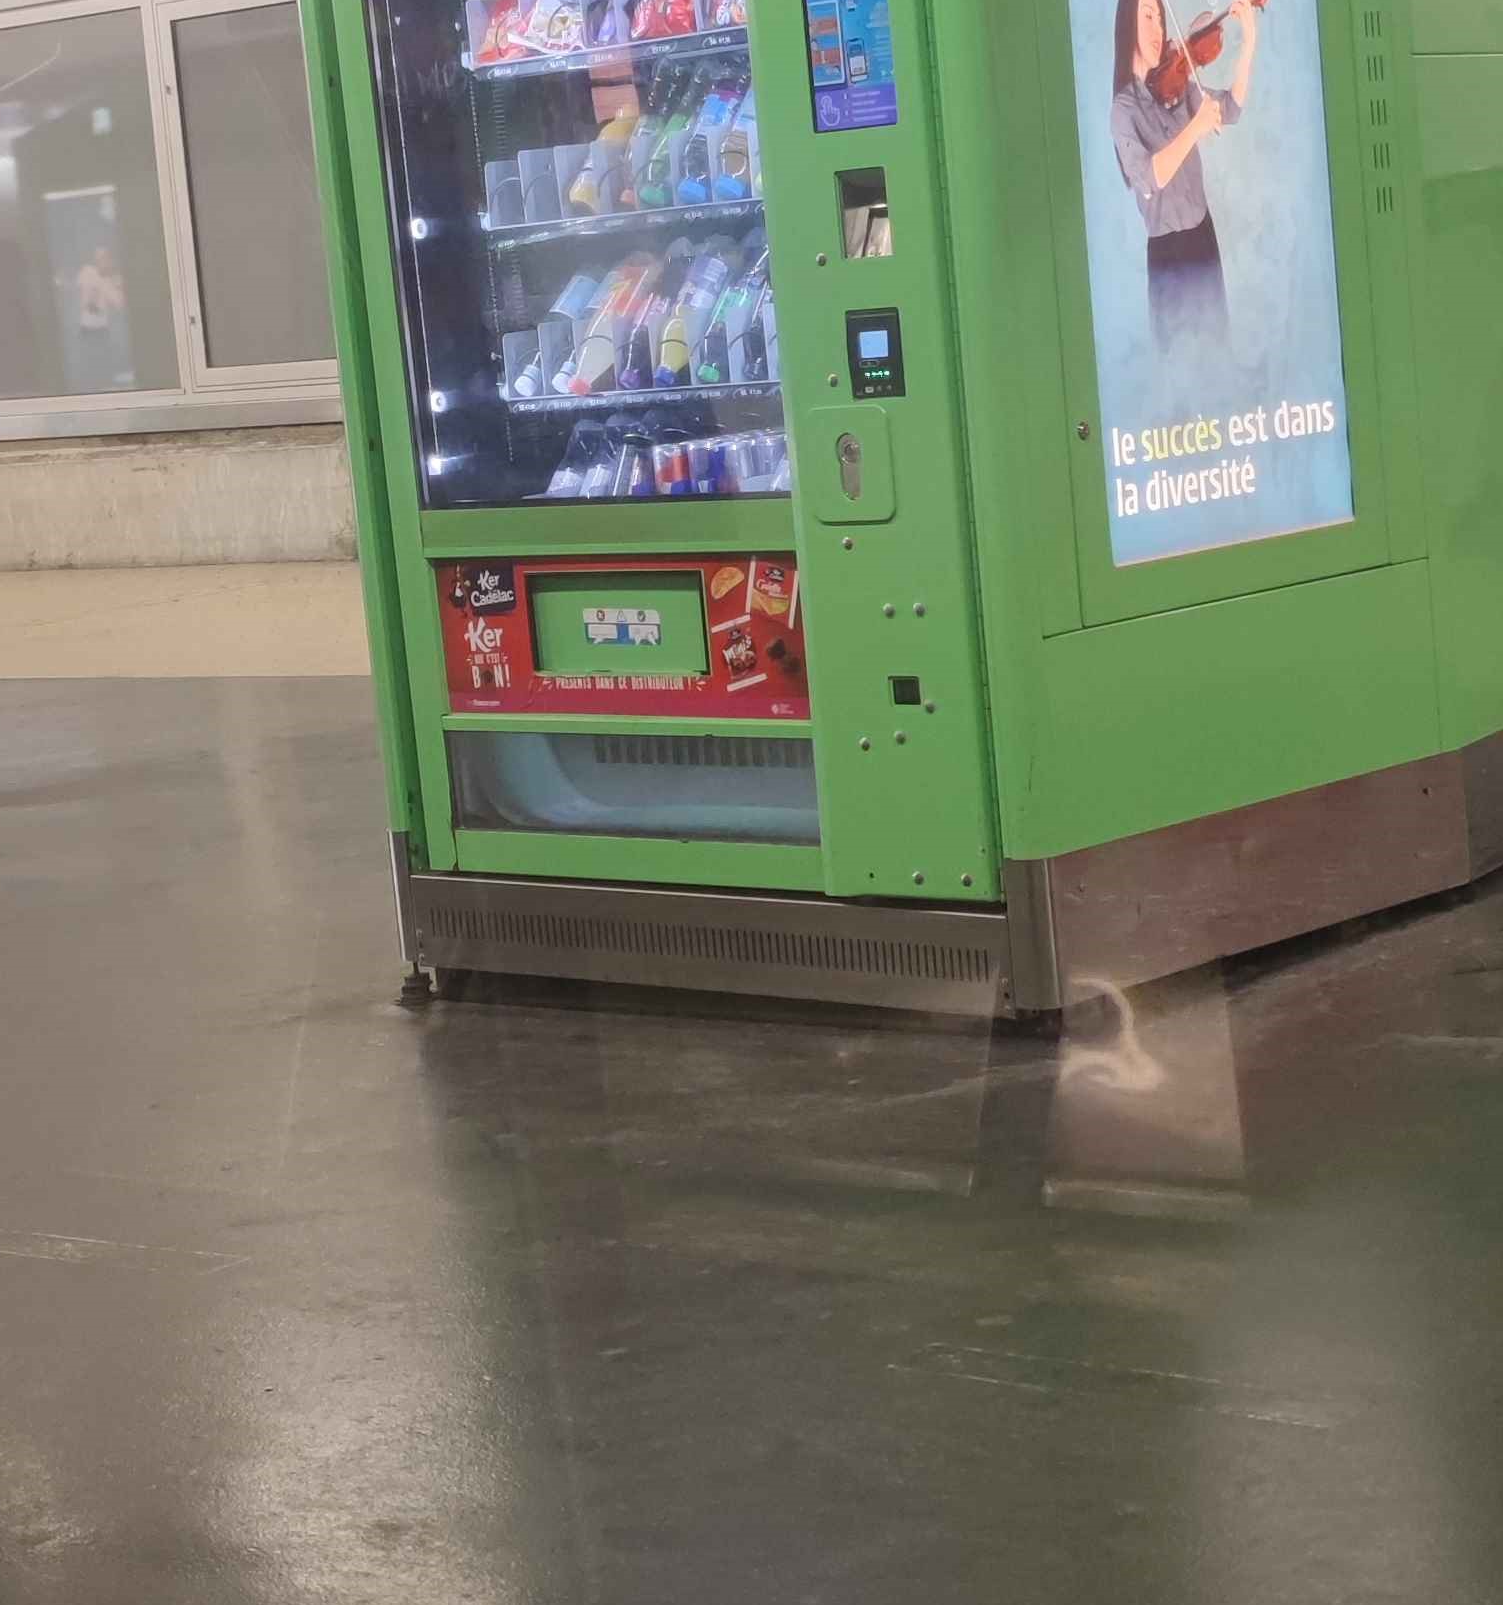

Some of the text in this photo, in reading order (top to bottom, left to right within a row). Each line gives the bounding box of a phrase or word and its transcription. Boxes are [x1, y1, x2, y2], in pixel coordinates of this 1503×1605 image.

[1112, 399, 1335, 467] le succès est dans
[1116, 455, 1256, 517] la diversité
[470, 588, 514, 608] Cadélac
[477, 569, 500, 591] Ker
[464, 616, 504, 653] Ker
